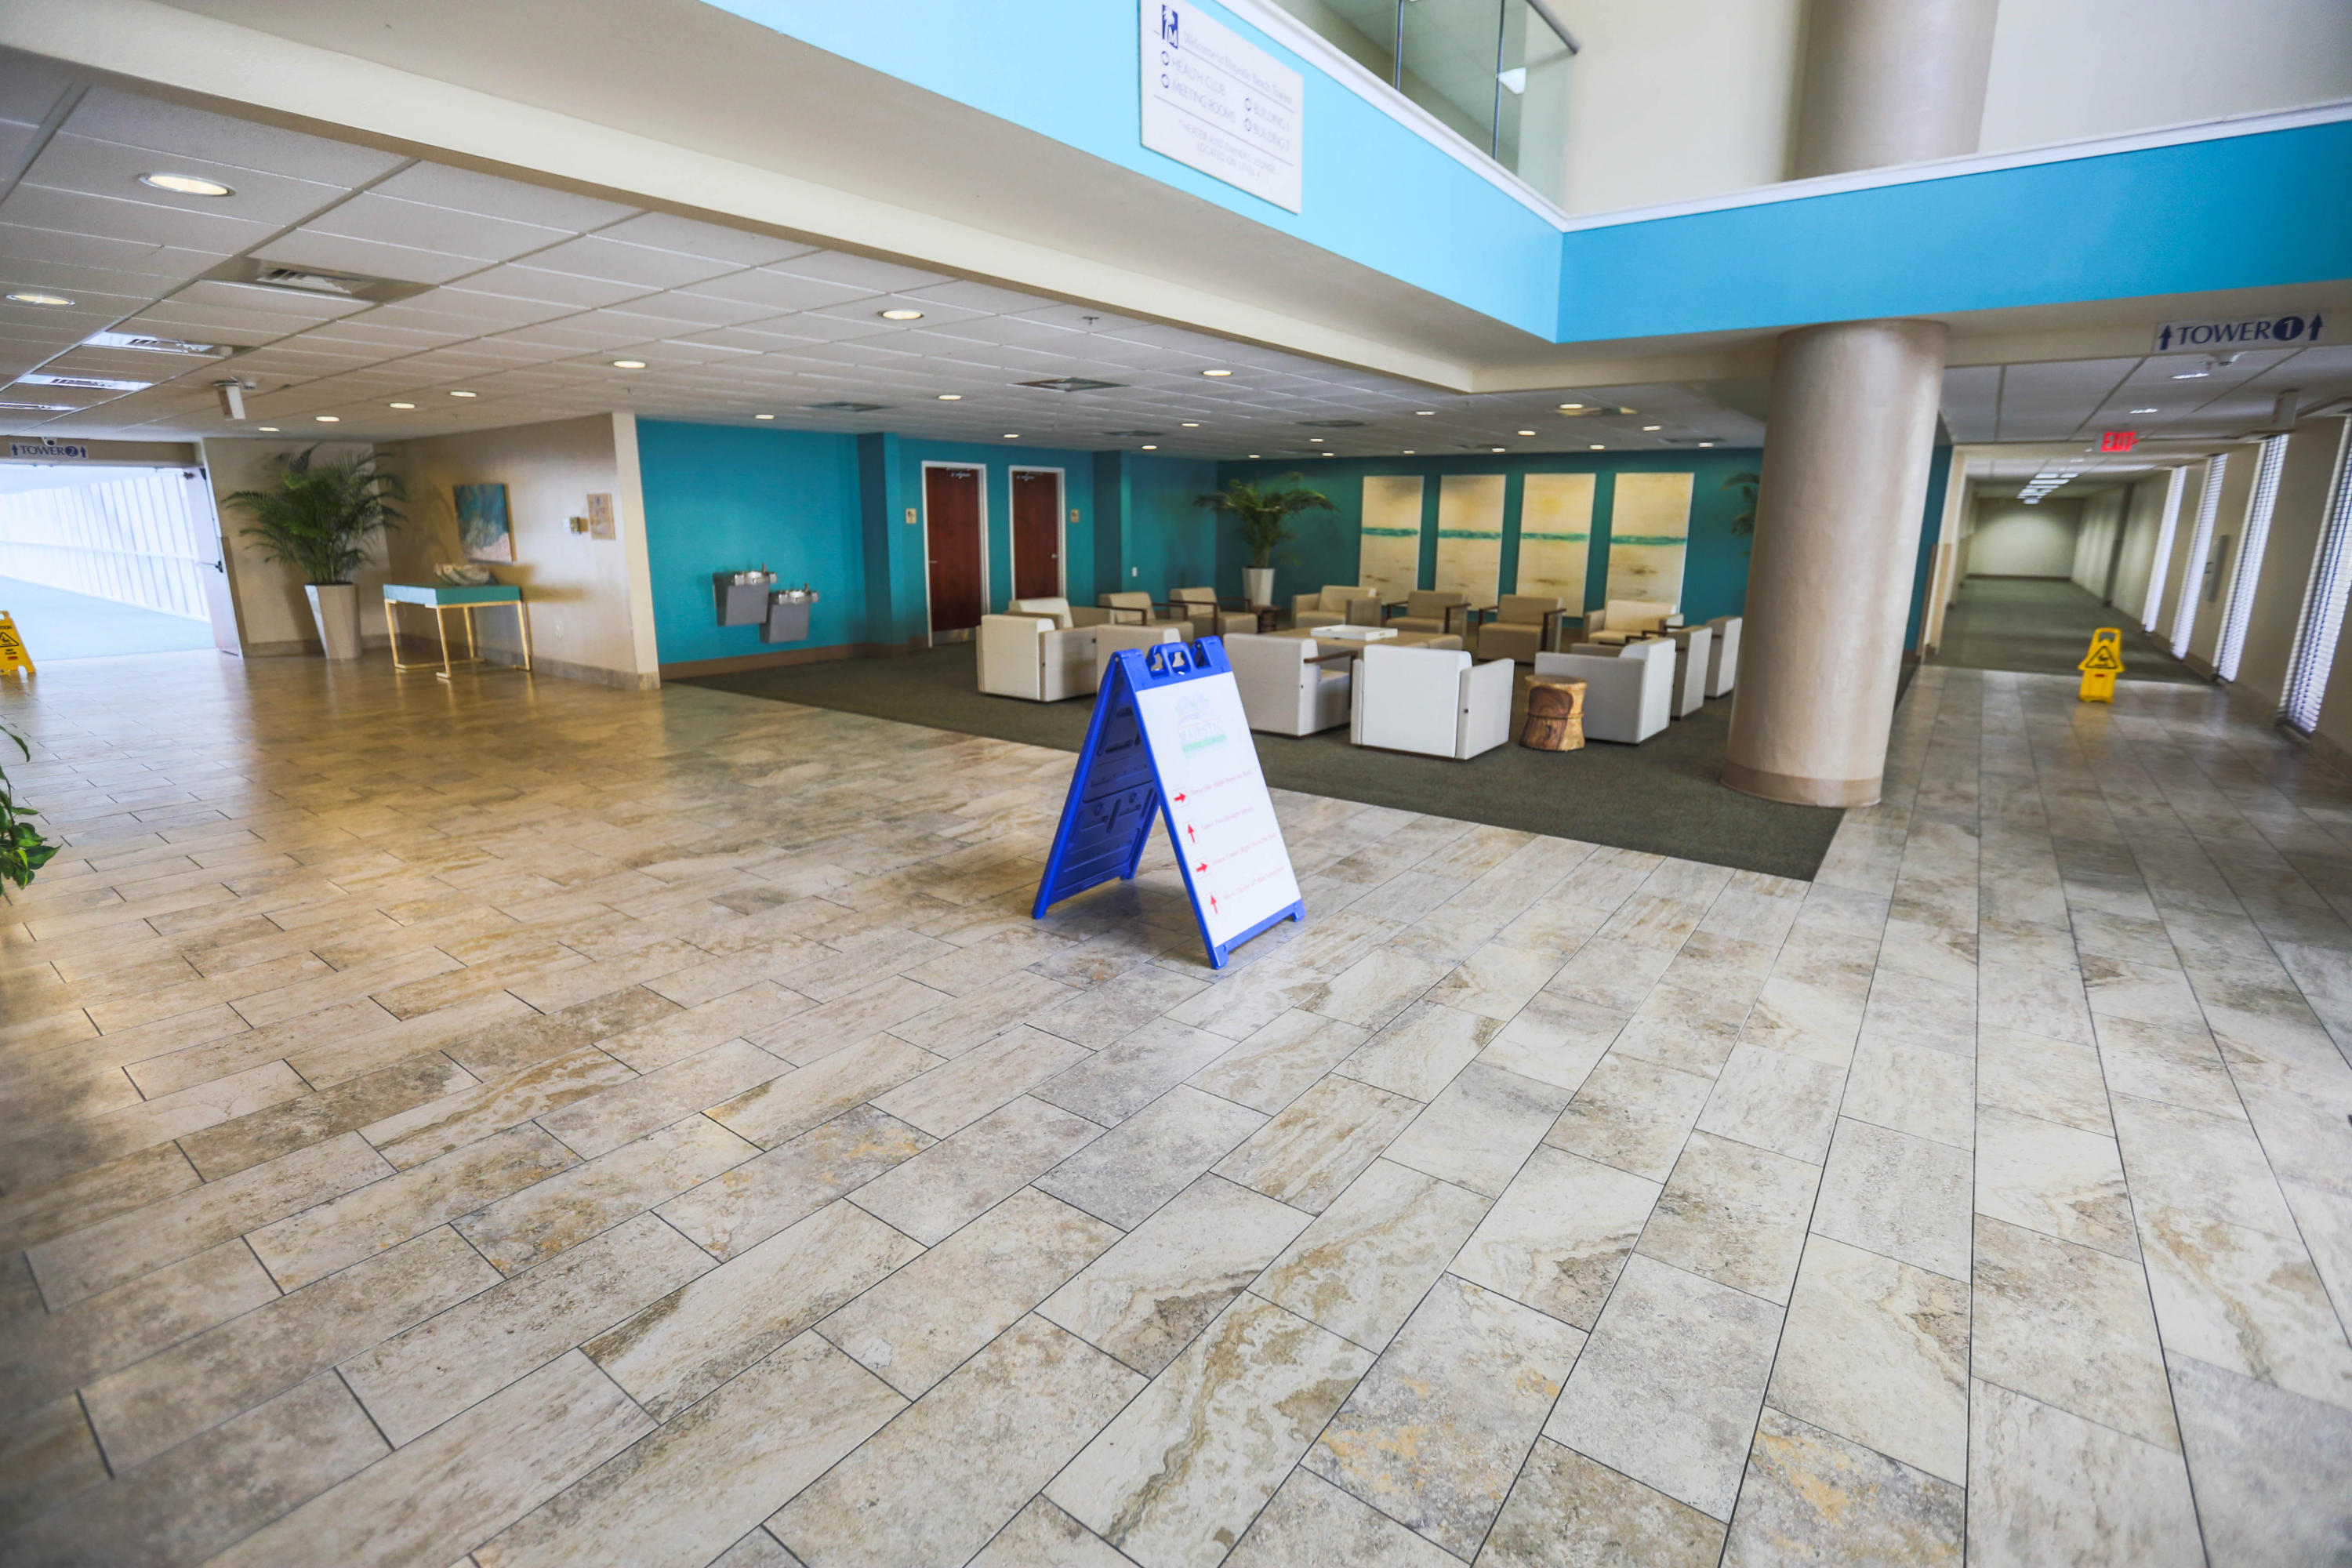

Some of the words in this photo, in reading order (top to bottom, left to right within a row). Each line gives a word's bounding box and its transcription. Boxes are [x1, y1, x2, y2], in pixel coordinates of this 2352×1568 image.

[1171, 57, 1203, 82] HEALTH
[1205, 76, 1226, 96] CLUB
[1172, 79, 1207, 109] MEETING
[1208, 97, 1236, 123] ROOMS
[2176, 321, 2271, 345] TOWER
[20, 445, 65, 456] TOWER
[2100, 432, 2136, 452] EXIT
